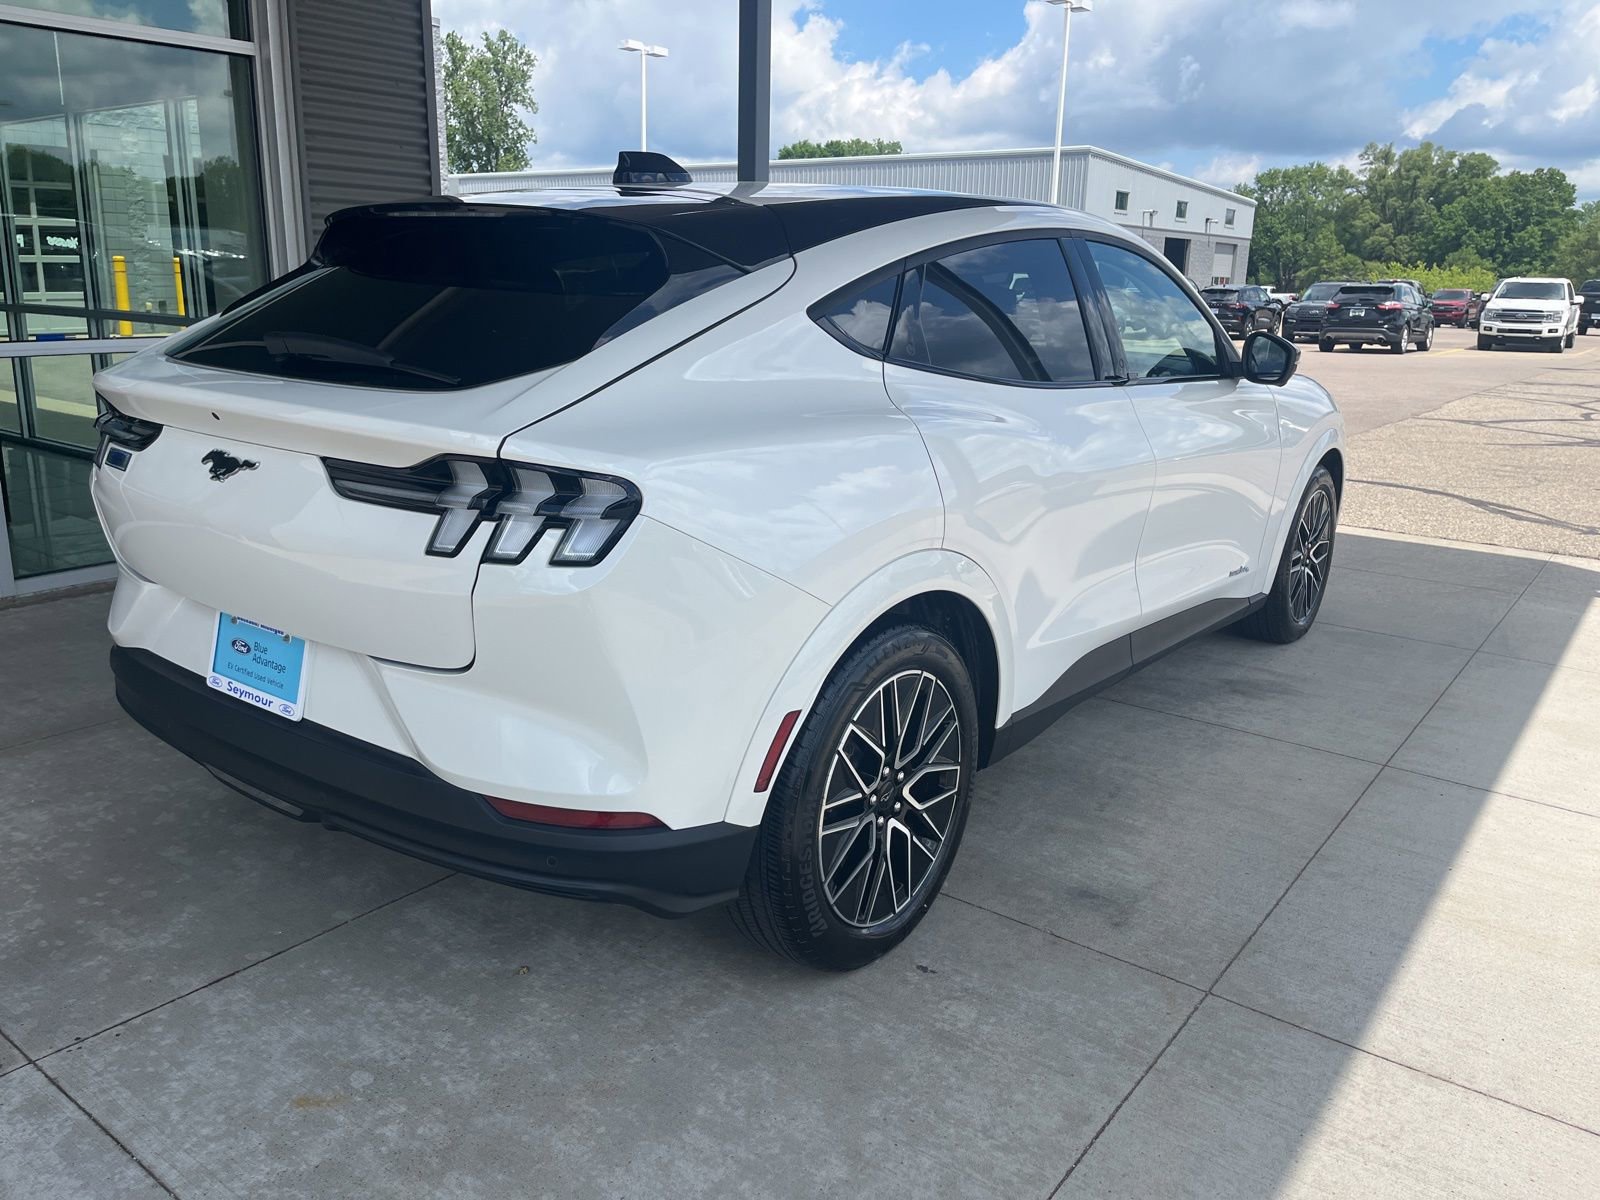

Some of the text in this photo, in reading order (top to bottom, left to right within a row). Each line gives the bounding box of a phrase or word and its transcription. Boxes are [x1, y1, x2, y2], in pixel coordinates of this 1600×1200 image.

[232, 639, 250, 654] Ford
[253, 641, 268, 655] Blue
[227, 662, 234, 670] EV
[234, 664, 254, 678] Certified
[254, 672, 267, 683] Used
[252, 653, 287, 674] Advantage
[226, 681, 274, 708] Seymour
